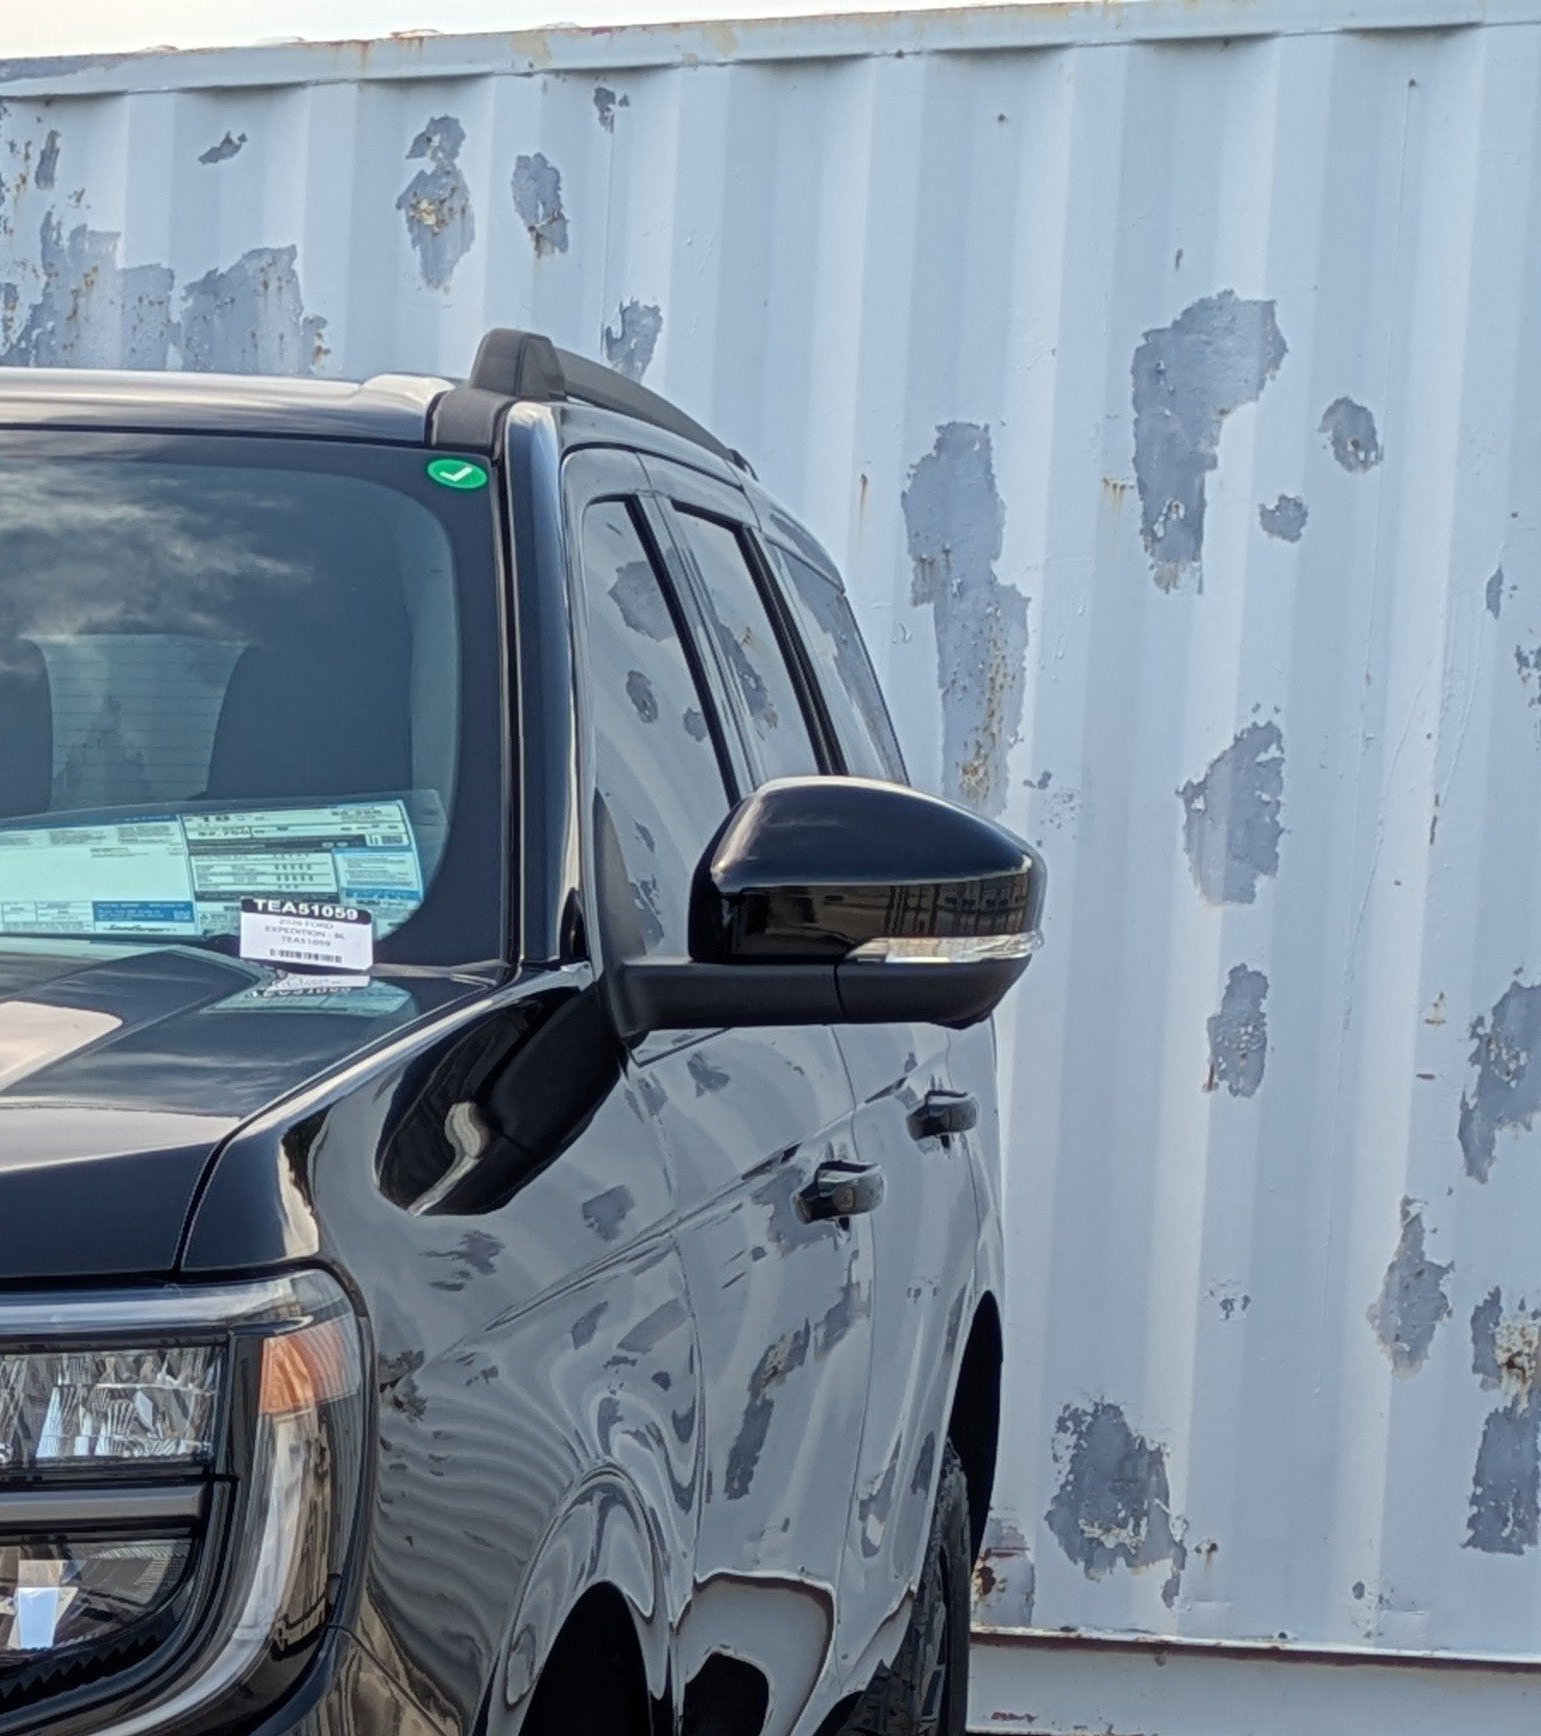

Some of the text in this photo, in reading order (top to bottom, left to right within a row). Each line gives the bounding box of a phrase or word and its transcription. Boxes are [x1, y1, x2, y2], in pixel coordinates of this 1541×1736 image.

[254, 898, 358, 920] TEA51059
[265, 926, 326, 938] EXPEDITION
[281, 936, 331, 947] TEA51059
